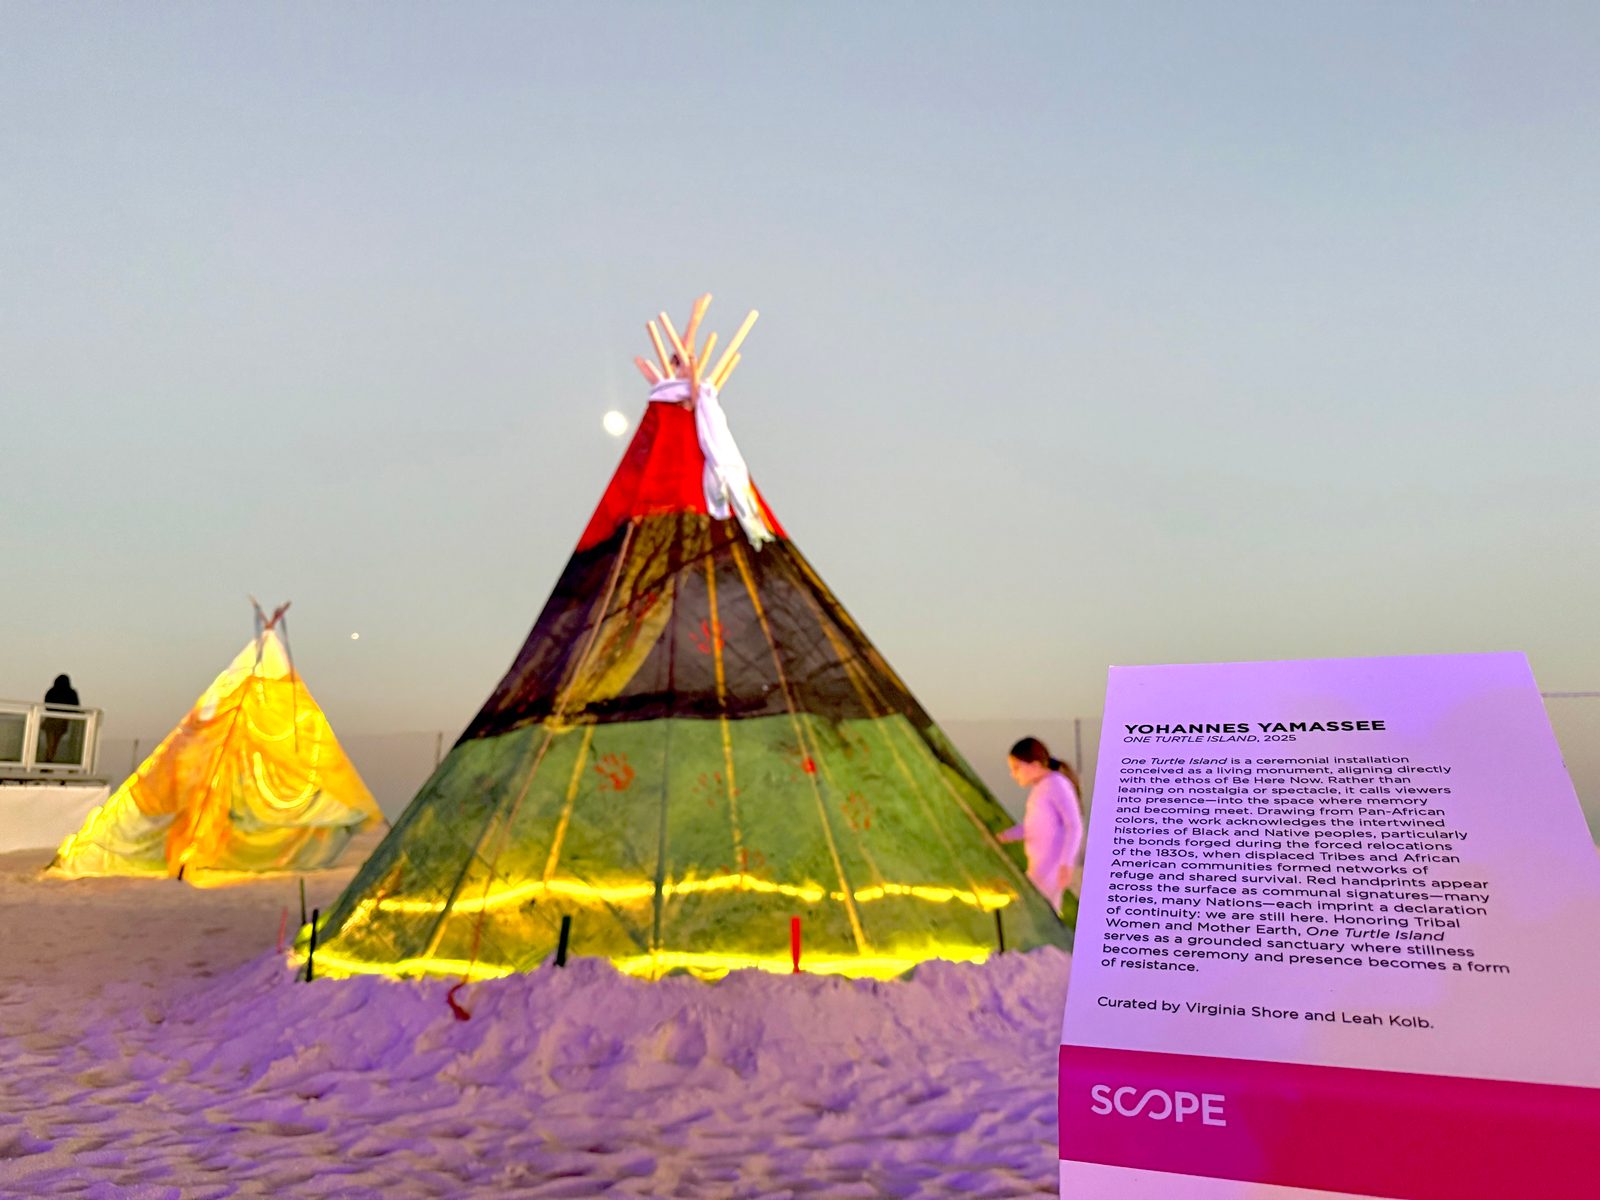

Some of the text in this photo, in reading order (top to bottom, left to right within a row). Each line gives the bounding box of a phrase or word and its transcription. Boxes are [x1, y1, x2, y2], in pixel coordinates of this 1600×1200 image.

[1125, 720, 1386, 734] YOHANNES YAMASSEE
[1207, 735, 1260, 743] ISLAND,
[1264, 734, 1296, 742] 2025
[1122, 758, 1146, 766] One
[1334, 756, 1409, 764] installation
[1217, 767, 1252, 775] living
[1338, 766, 1392, 775] aligning
[1397, 765, 1451, 774] directly
[1150, 776, 1170, 784] the
[1214, 776, 1229, 784] of
[1233, 776, 1250, 784] Be
[1254, 776, 1285, 784] Here
[1290, 776, 1323, 784] Now.
[1328, 776, 1374, 784] Rather
[1118, 786, 1164, 795] leaning
[1189, 786, 1249, 795] nostalgia
[1272, 786, 1341, 795] spectacle,
[1345, 786, 1355, 794] it
[1359, 786, 1391, 794] calls
[1395, 786, 1451, 794] viewers
[1274, 798, 1314, 806] space
[1319, 797, 1362, 805] where
[1367, 798, 1427, 806] memory
[1144, 806, 1210, 816] becoming
[1214, 807, 1253, 815] meet.
[1258, 807, 1315, 817] Drawing
[1319, 807, 1353, 815] from
[1358, 808, 1445, 816] Pan-African
[1115, 816, 1445, 827] colors, the work acknowledges the intertwined
[1114, 826, 1467, 840] histories of Black and Native peoples, particularly
[1114, 837, 1453, 851] the bonds forged during the forced relocations
[1112, 848, 1460, 863] of the 1830s, when displaced Tribes and African
[1111, 859, 1428, 875] American communities formed networks of
[1110, 870, 1488, 890] refuge and shared survival. Red handprints appear
[1109, 883, 1153, 891] across
[1157, 883, 1180, 892] the
[1184, 885, 1237, 895] surface
[1262, 888, 1341, 898] communal
[1108, 894, 1157, 905] stories,
[1162, 898, 1201, 907] many
[1318, 900, 1374, 912] imprint
[1380, 904, 1388, 912] a
[1394, 903, 1487, 915] declaration
[1106, 906, 1121, 915] of
[1125, 908, 1200, 920] continuity:
[1232, 912, 1254, 920] are
[1260, 912, 1285, 922] still
[1290, 912, 1328, 923] here.
[1334, 914, 1408, 928] Honoring
[1414, 917, 1460, 928] Tribal
[1106, 918, 1445, 941] Women and Mother Earth, One Turtle Island
[1104, 933, 1475, 957] serves as a grounded sanctuary where stillness
[1101, 957, 1199, 972] of resistance.
[1103, 943, 1510, 974] becomes ceremony and presence becomes a form
[1098, 996, 1434, 1029] Curated by Virginia Shore and Leah Kolb.
[1091, 1084, 1226, 1126] SCOPE
